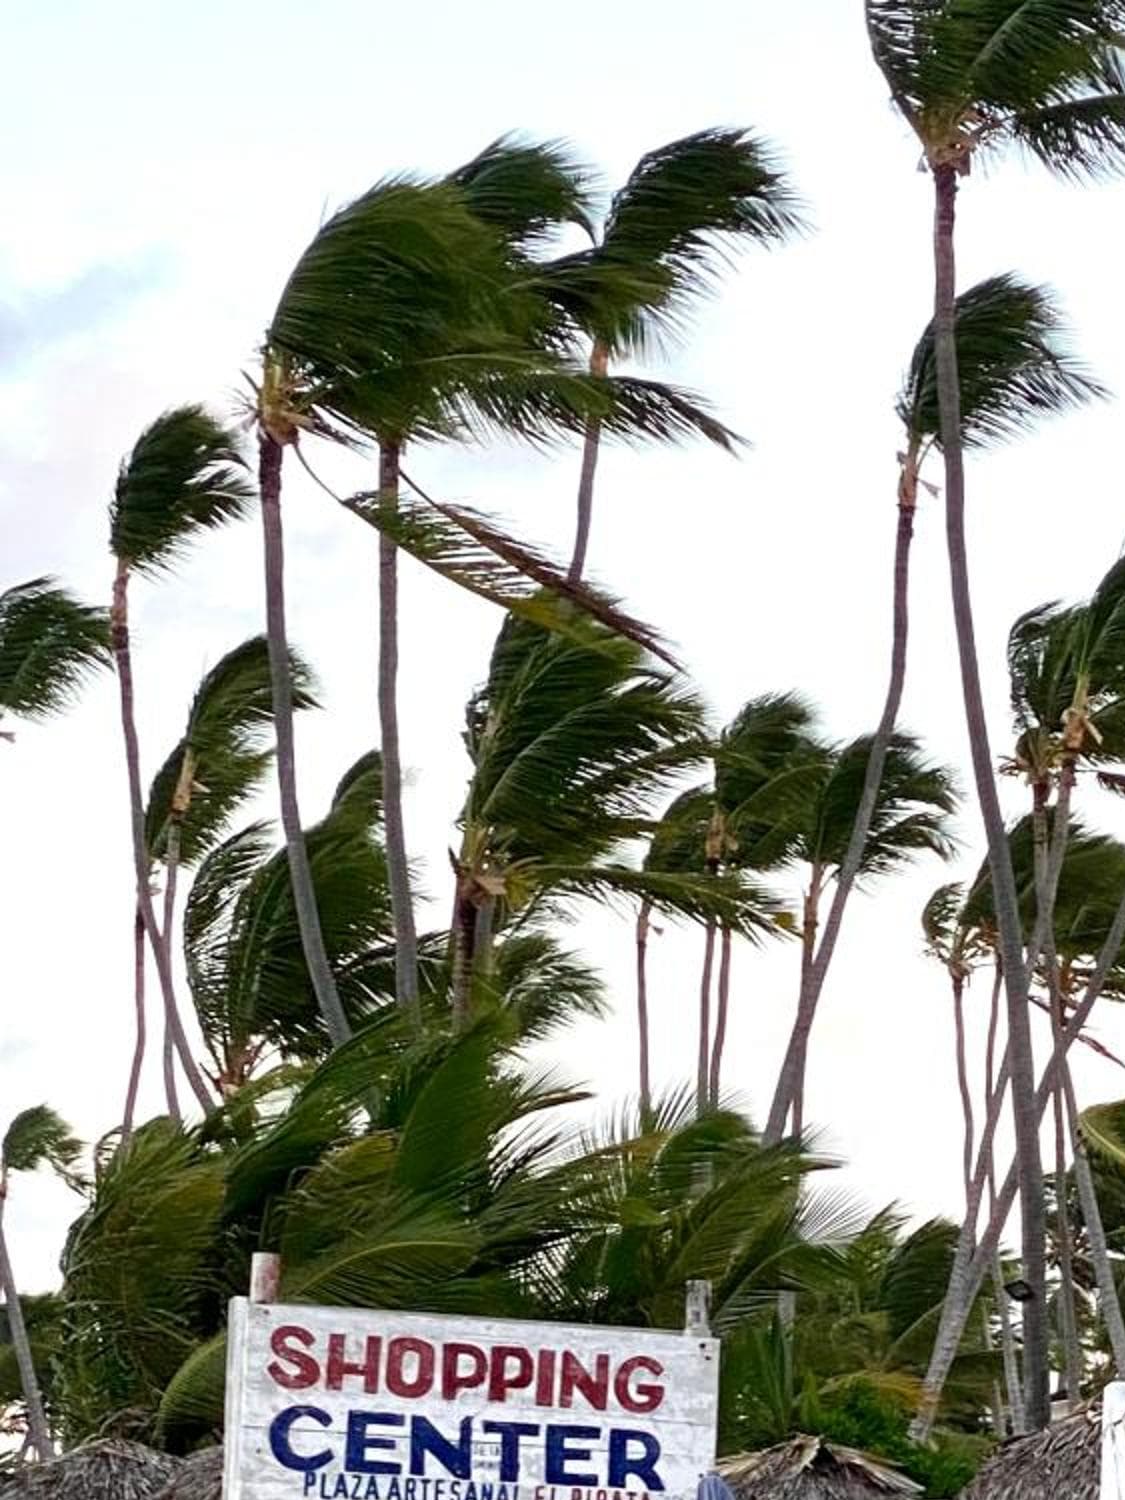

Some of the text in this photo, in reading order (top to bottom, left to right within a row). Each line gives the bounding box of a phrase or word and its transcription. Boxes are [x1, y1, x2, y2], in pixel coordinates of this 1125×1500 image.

[267, 1325, 666, 1414] SHOPPING
[268, 1405, 665, 1491] CENTER
[303, 1471, 379, 1500] PLAZA
